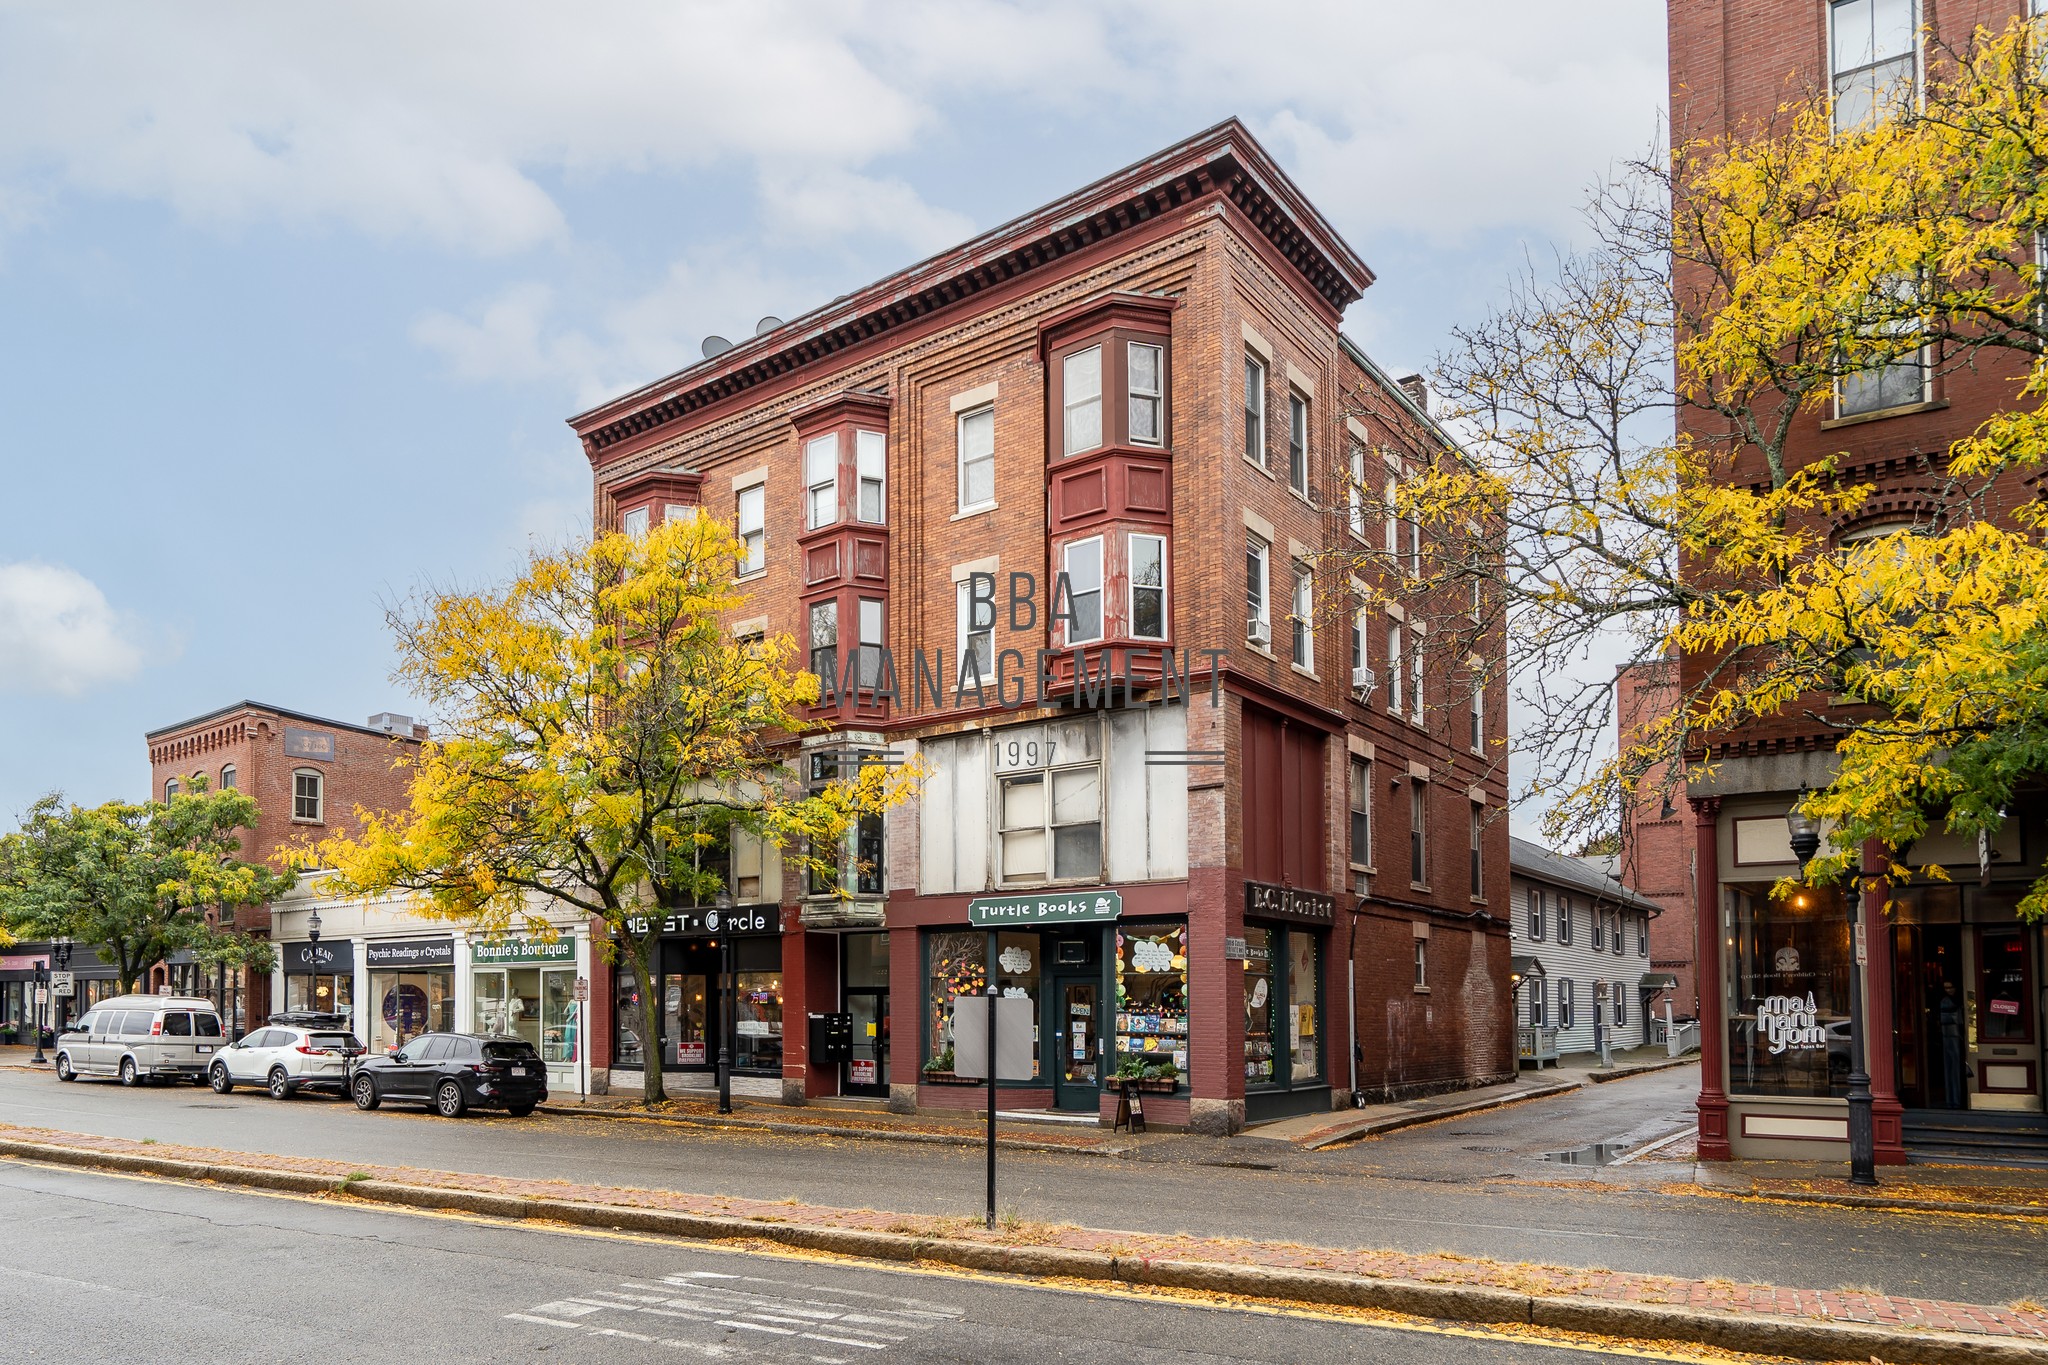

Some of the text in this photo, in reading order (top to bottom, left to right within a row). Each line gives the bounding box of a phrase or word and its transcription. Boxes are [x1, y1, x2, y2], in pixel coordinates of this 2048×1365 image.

[979, 900, 1087, 919] Turtle Books
[1280, 890, 1332, 918] Florist
[705, 909, 766, 932] Crcle
[368, 948, 391, 960] Psychic
[391, 947, 419, 959] Readings
[425, 945, 451, 958] Crystals
[477, 942, 569, 957] Bonnie's Boutique
[1764, 996, 1804, 1014] ma
[1757, 1005, 1815, 1031] hani
[1768, 1026, 1826, 1054] yom
